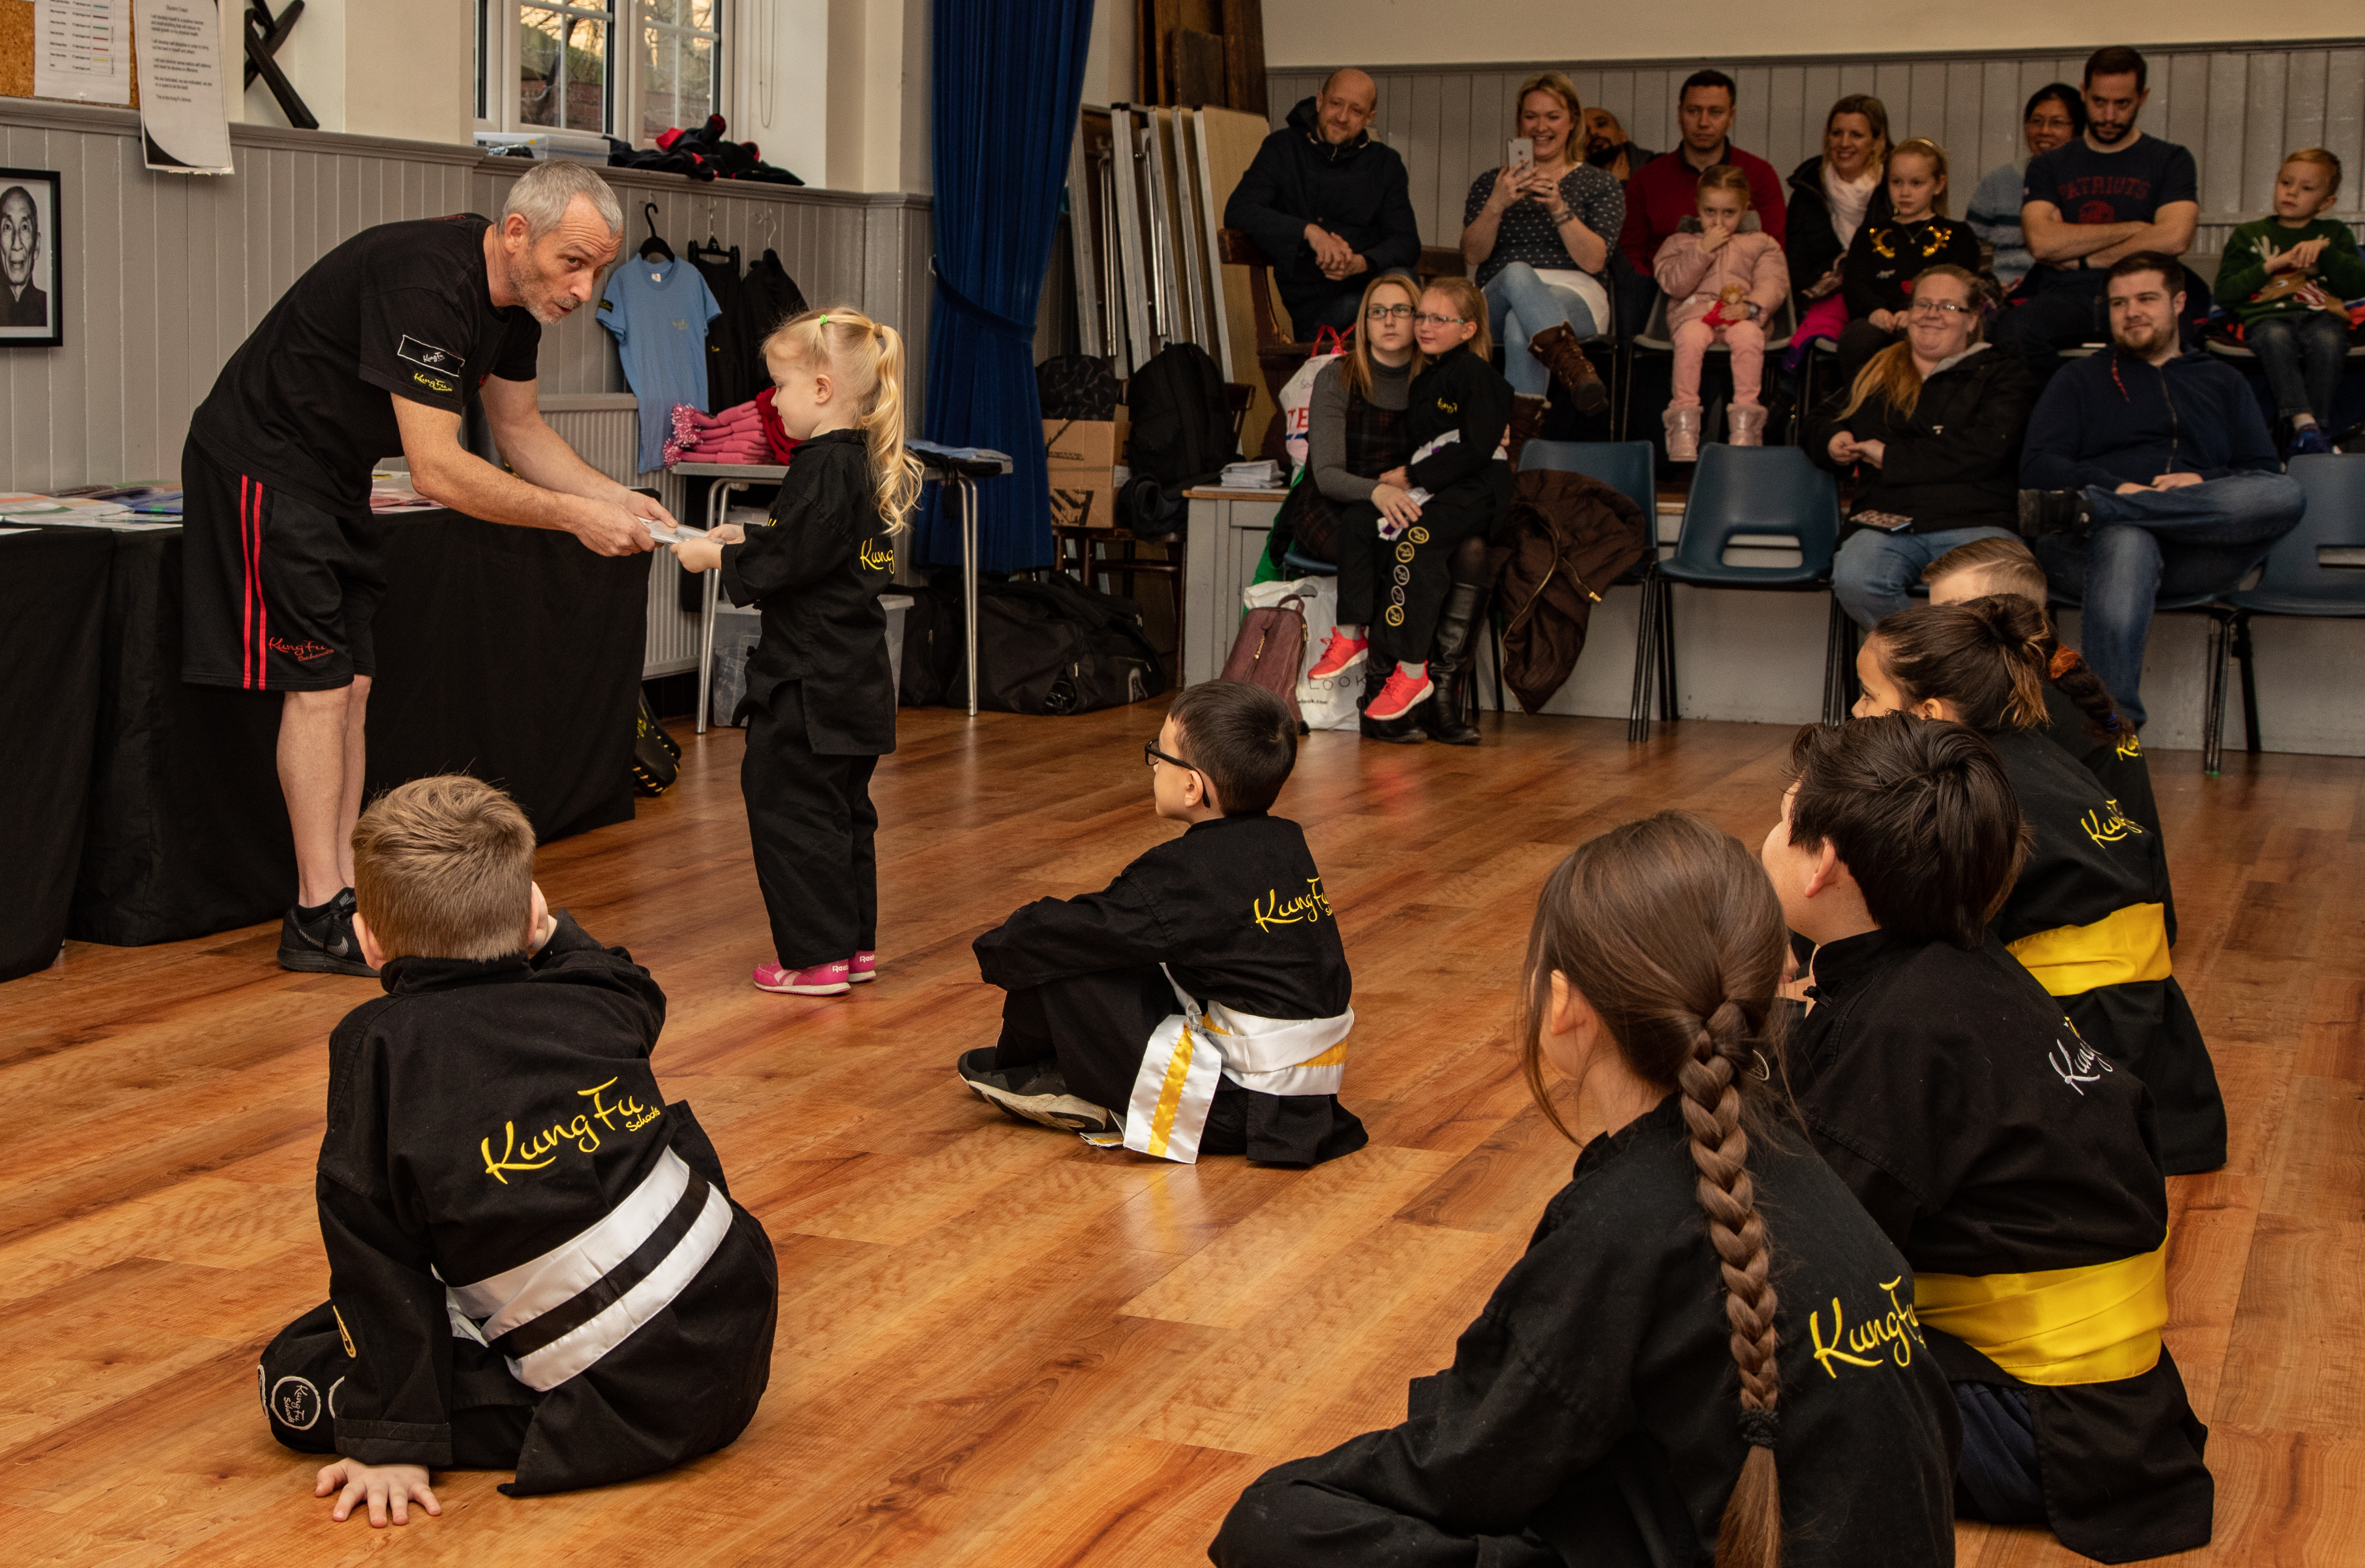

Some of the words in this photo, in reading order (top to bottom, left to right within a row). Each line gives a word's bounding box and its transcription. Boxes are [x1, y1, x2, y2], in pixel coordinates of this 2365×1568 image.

[413, 373, 435, 388] Kung
[435, 378, 447, 389] Fu
[860, 538, 895, 574] Kung
[268, 637, 304, 656] Kung
[303, 640, 327, 653] Fu
[1254, 889, 1318, 933] Kung
[481, 1114, 601, 1185] Kung
[577, 1076, 644, 1131] Fu
[625, 1105, 661, 1132] Schools
[1810, 1296, 1911, 1379] Kung
[291, 1384, 308, 1409] Kung
